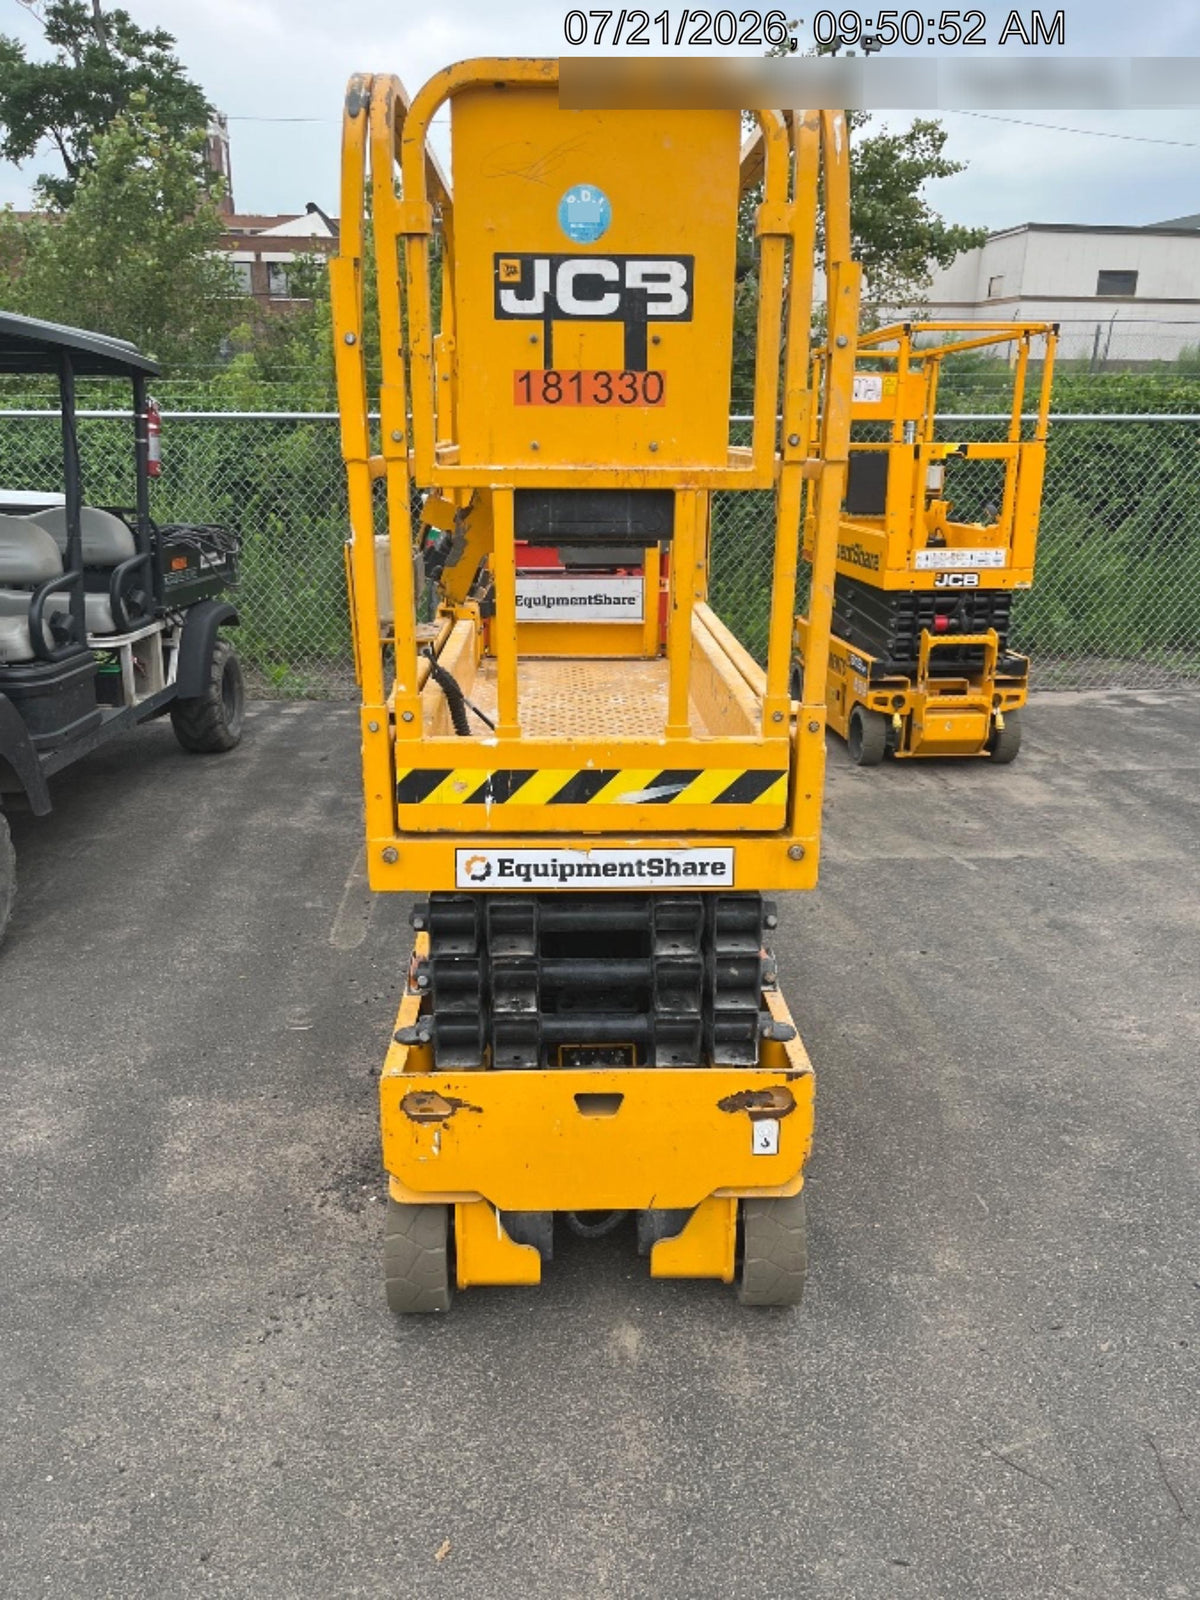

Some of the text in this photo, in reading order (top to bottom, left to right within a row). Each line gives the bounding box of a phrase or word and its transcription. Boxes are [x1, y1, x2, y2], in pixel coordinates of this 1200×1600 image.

[500, 258, 688, 316] JCB
[518, 370, 664, 404] 181330
[934, 573, 979, 587] JCB
[514, 593, 636, 608] EquipmentShare
[497, 858, 726, 882] EquipmentShare
